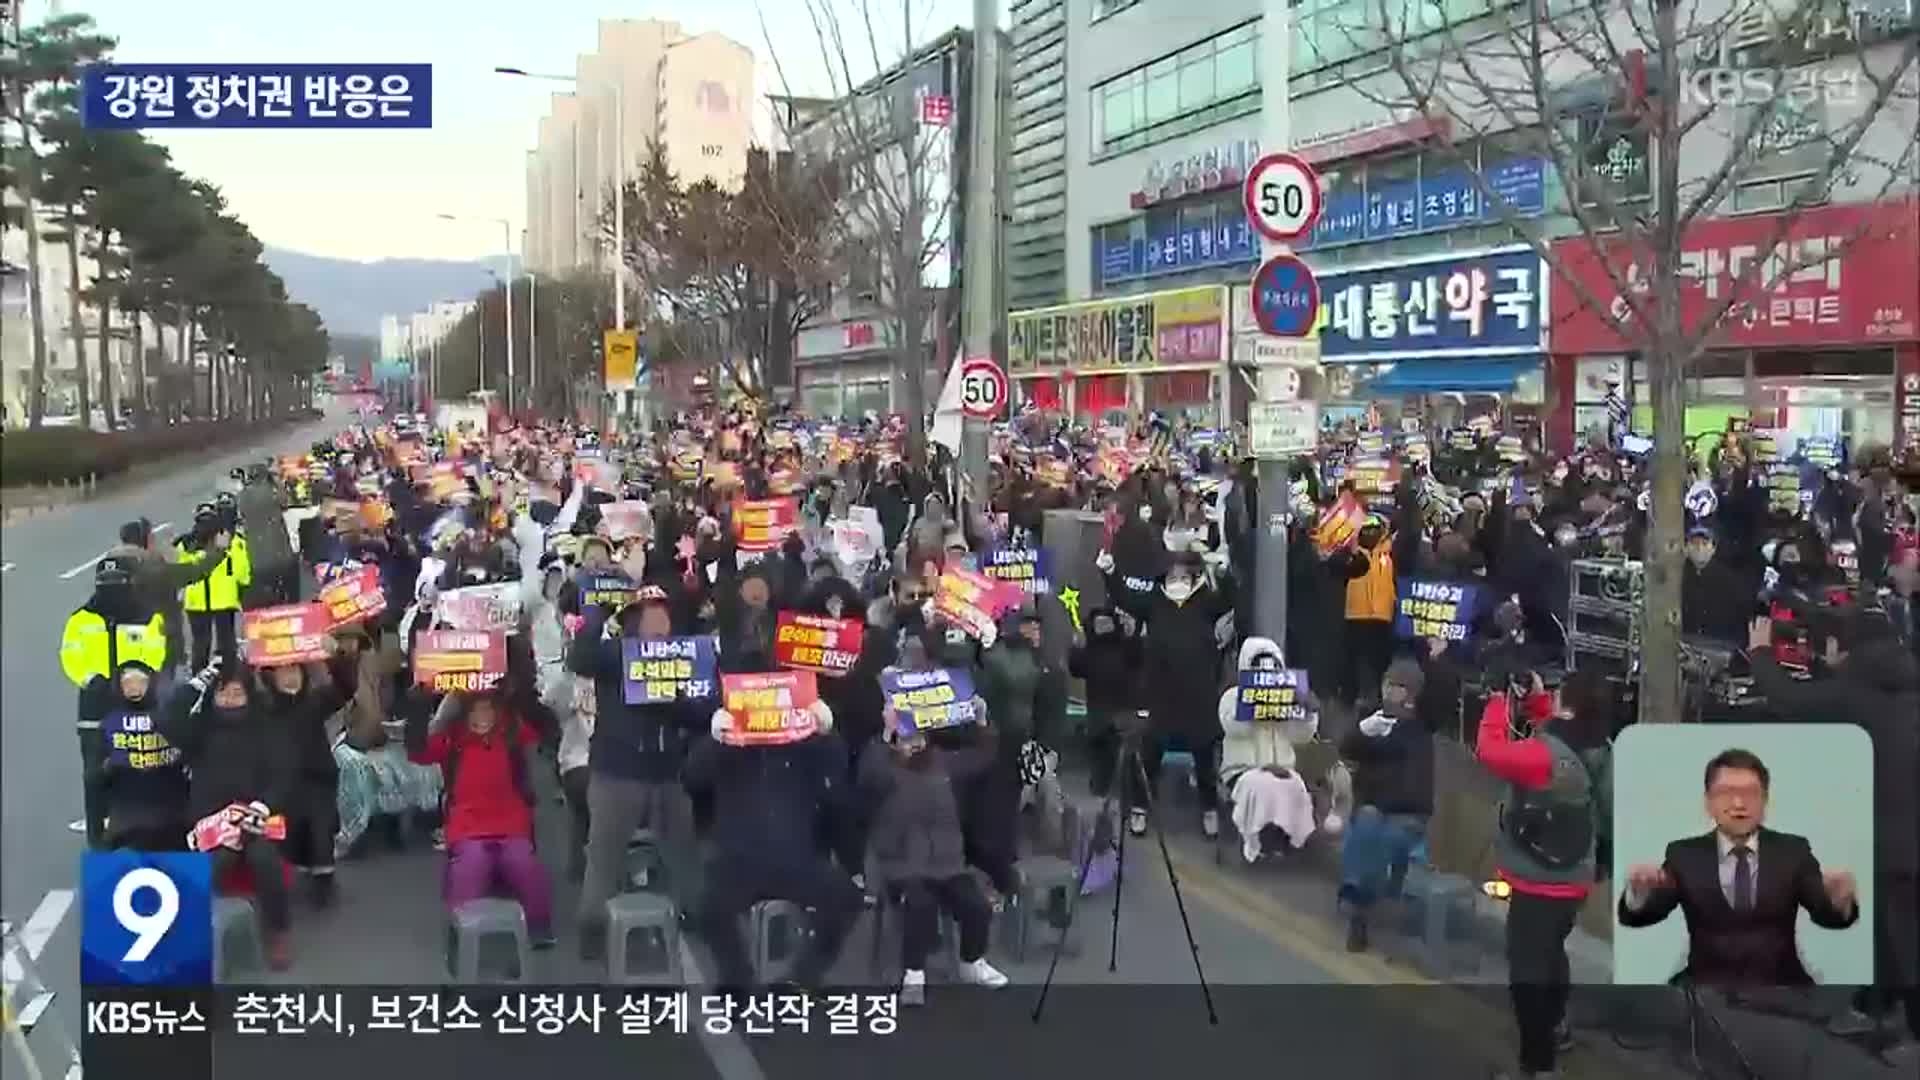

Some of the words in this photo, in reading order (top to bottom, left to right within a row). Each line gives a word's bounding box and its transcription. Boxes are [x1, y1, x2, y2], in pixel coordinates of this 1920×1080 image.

[1262, 182, 1303, 218] 50
[1332, 266, 1534, 341] 대룡산약국
[965, 377, 997, 404] 50
